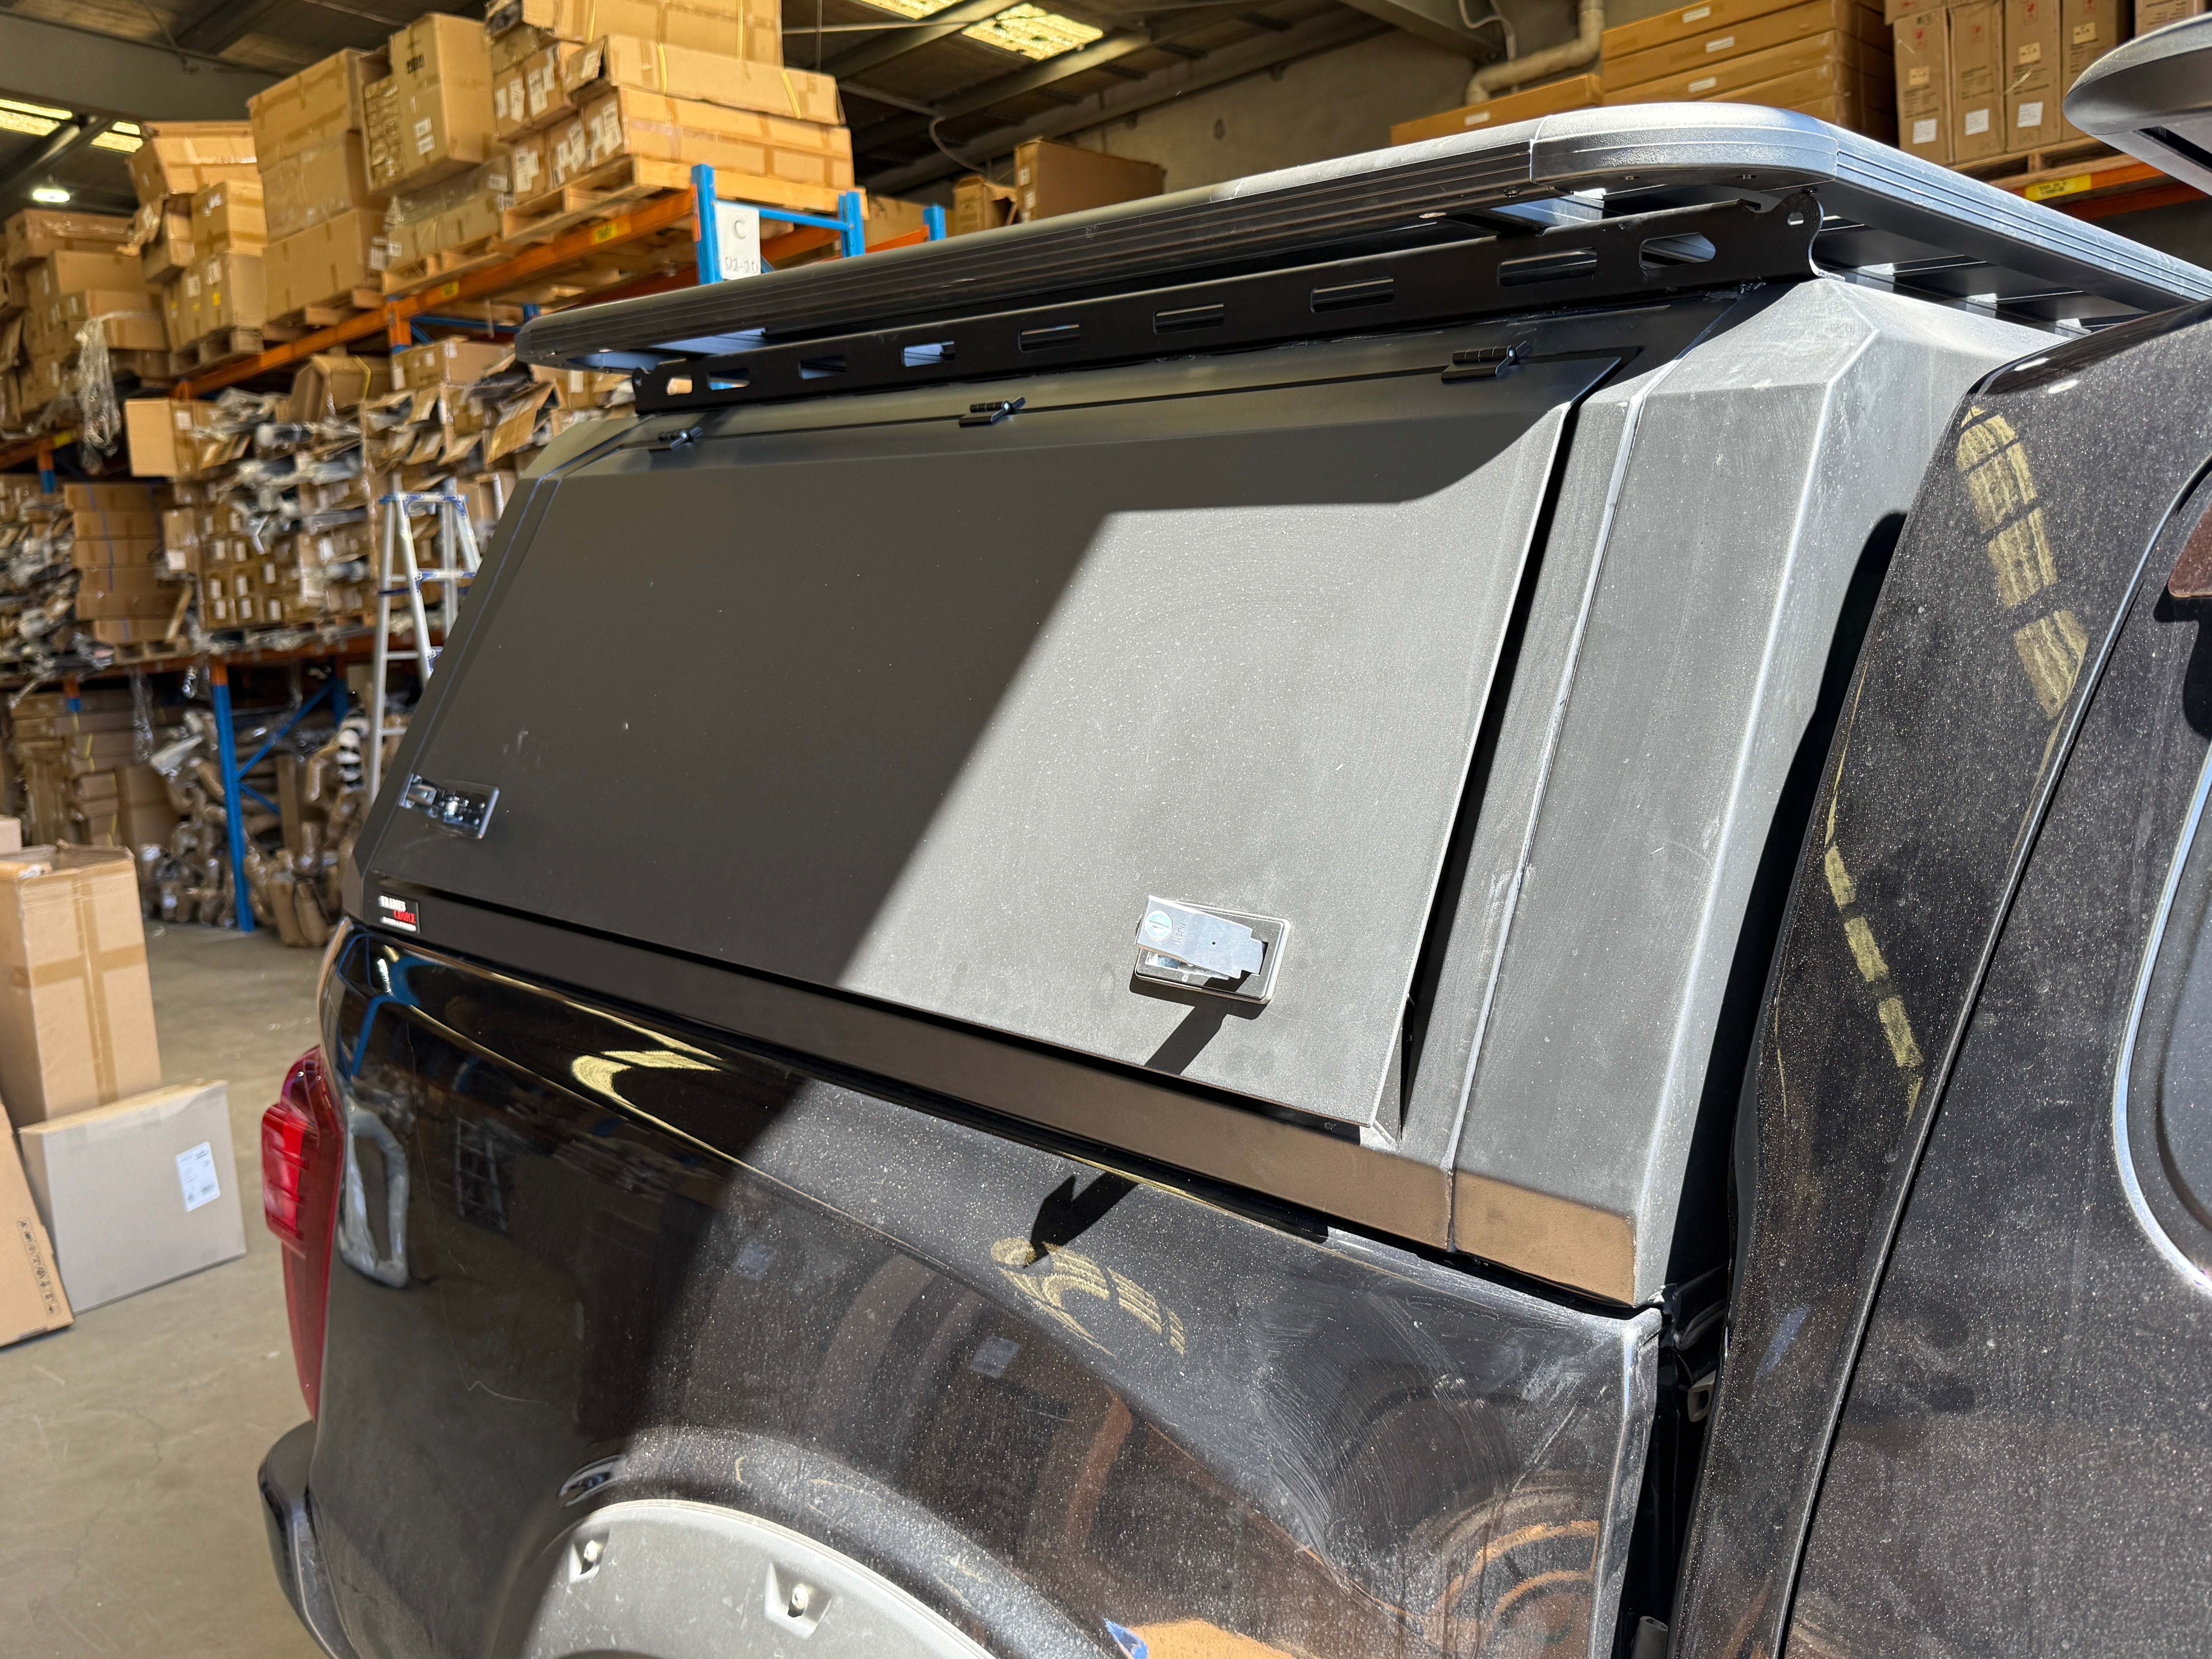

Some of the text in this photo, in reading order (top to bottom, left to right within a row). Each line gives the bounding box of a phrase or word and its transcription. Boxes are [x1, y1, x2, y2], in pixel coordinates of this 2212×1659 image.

[732, 218, 746, 239] C
[393, 910, 416, 924] CHOICE
[1175, 923, 1186, 944] PUSH
